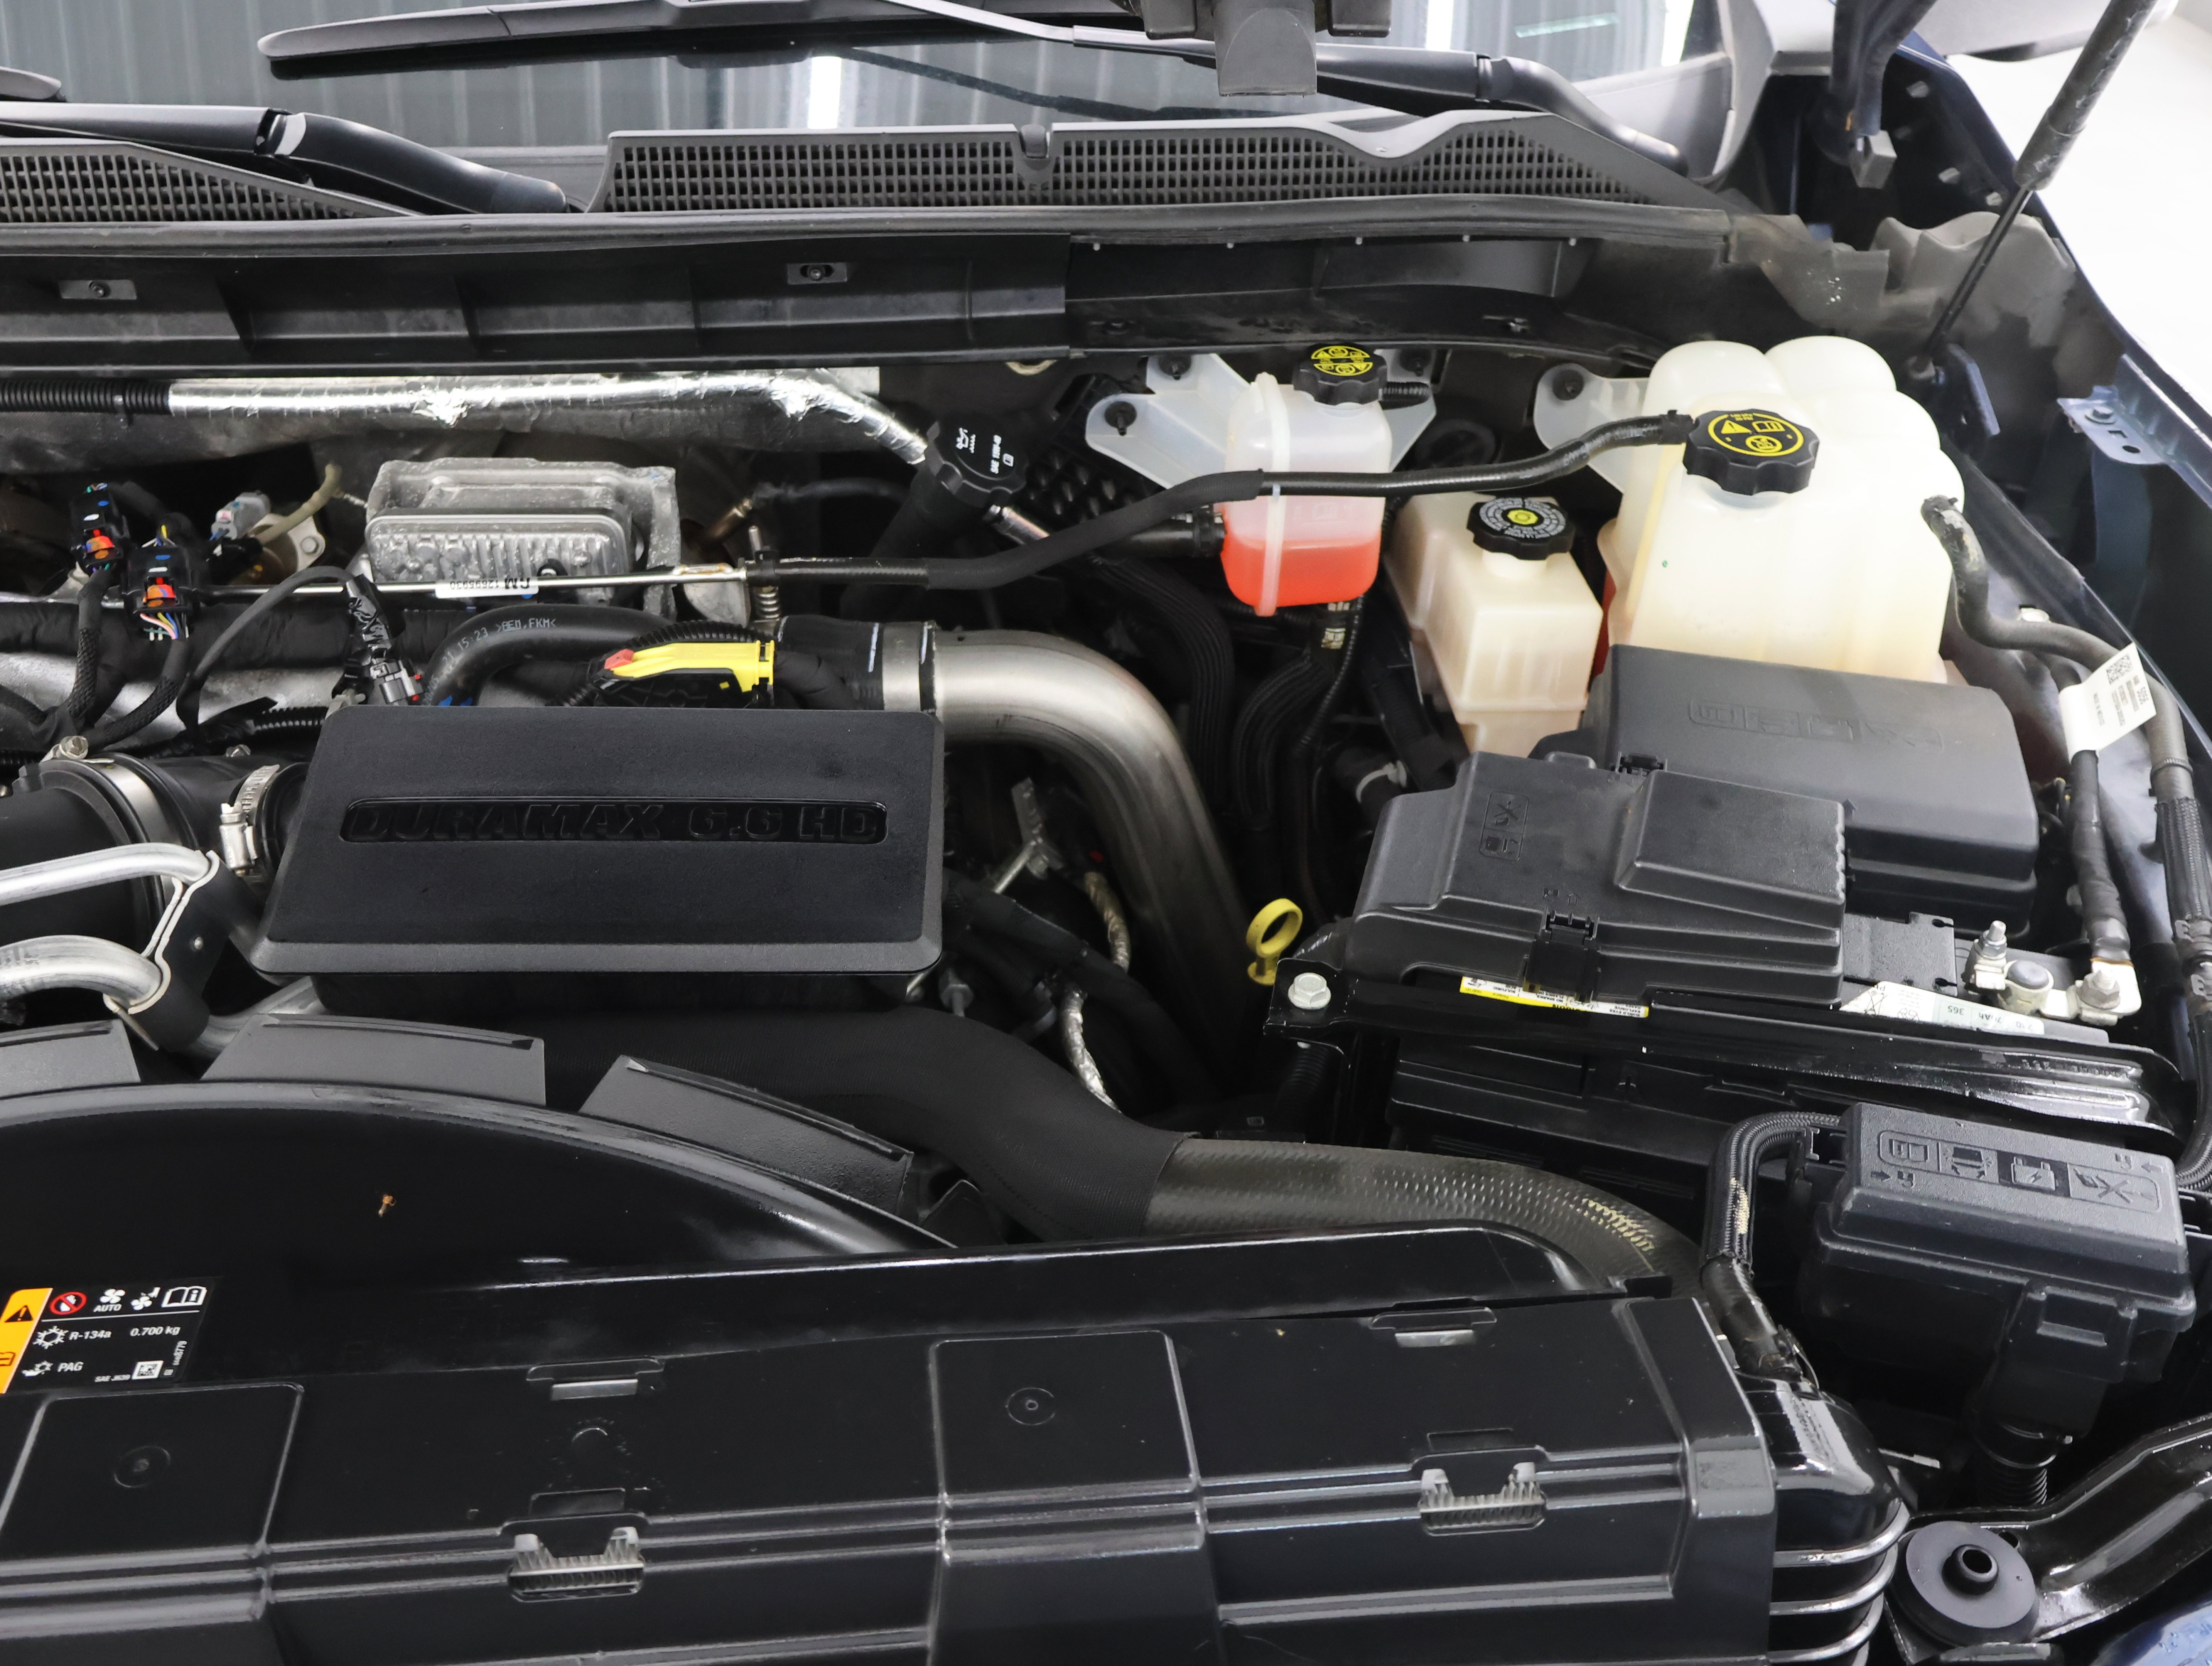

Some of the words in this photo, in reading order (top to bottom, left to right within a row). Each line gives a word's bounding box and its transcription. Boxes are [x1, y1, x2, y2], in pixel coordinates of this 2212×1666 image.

[450, 579, 499, 590] 12695930
[505, 578, 530, 590] GM
[350, 804, 664, 840] DURAMAX
[688, 805, 783, 839] 6.6
[798, 806, 879, 841] HD
[1947, 1005, 1964, 1015] 365
[93, 1303, 121, 1313] AUTO
[69, 1330, 112, 1340] R-134a
[130, 1326, 164, 1337] 0.700
[165, 1325, 181, 1337] kg
[57, 1361, 84, 1373] PAG
